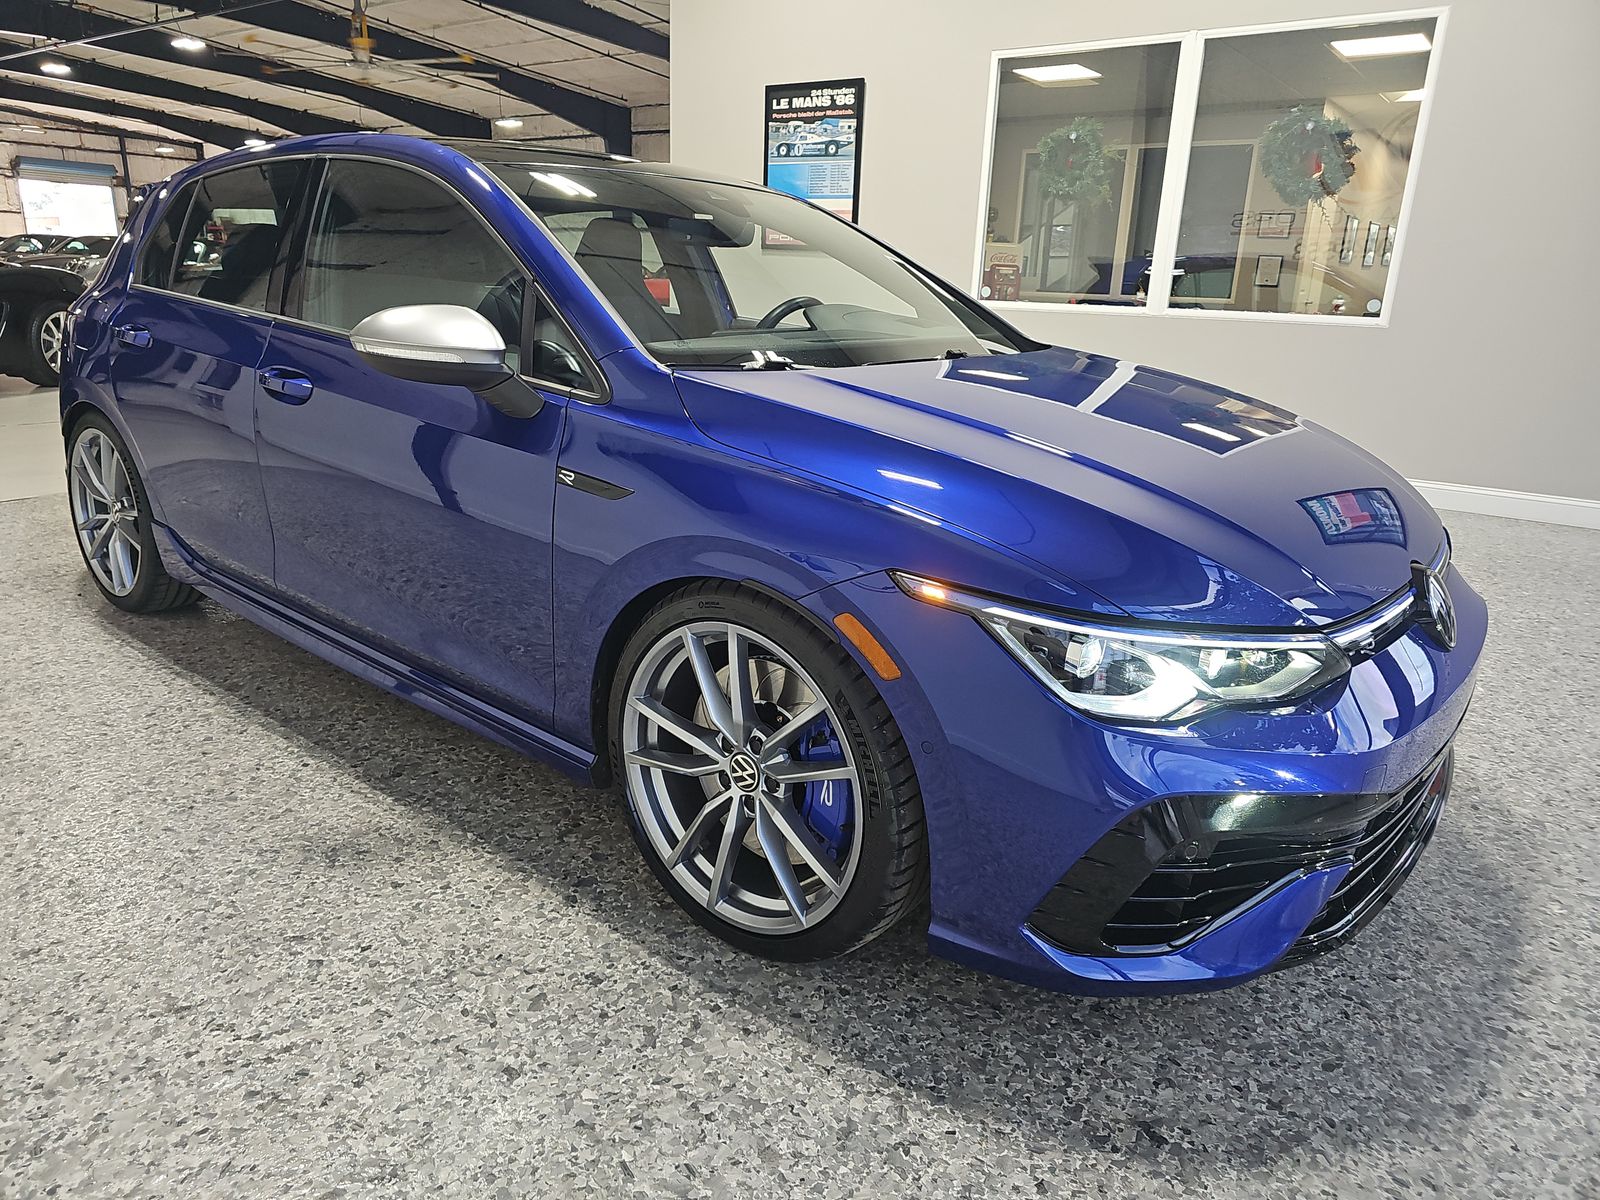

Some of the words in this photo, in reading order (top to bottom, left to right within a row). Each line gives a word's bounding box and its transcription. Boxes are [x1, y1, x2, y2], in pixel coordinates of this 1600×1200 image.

[810, 89, 821, 97] 24
[822, 87, 856, 95] Stunden
[772, 98, 789, 109] LE
[792, 96, 832, 109] MANS
[833, 94, 855, 105] '86
[797, 110, 815, 118] bleibt
[559, 470, 575, 486] R
